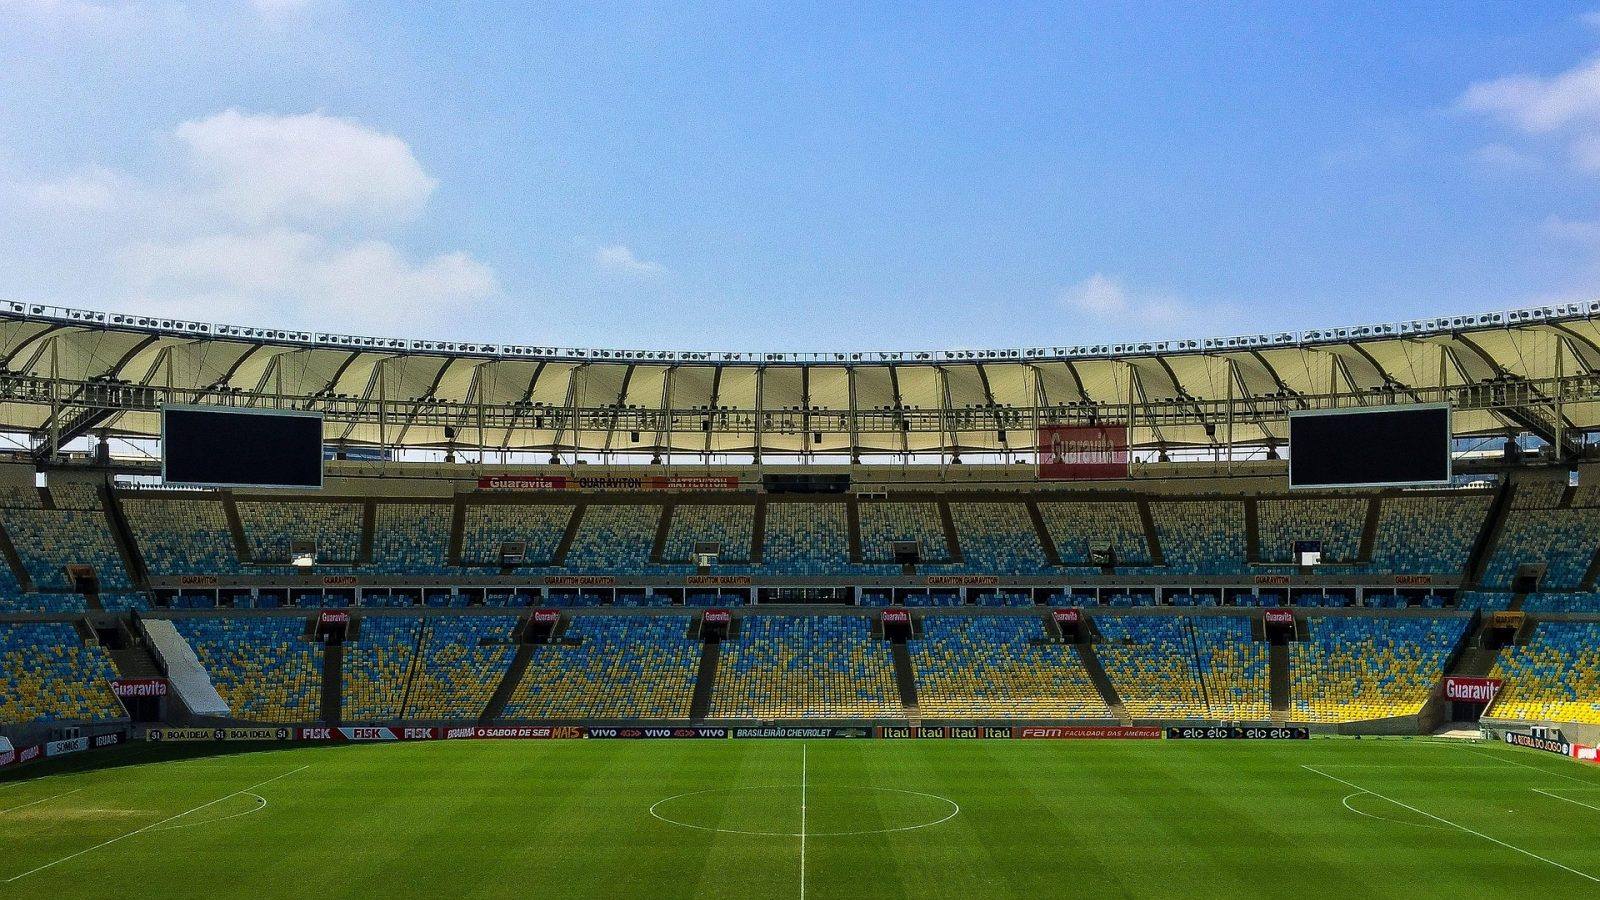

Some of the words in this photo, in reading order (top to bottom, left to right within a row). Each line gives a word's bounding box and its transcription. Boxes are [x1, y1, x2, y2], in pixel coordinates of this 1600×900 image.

[1052, 432, 1114, 464] Guaravita
[490, 478, 553, 488] Guaravita
[579, 477, 642, 488] GUARAVITON
[1266, 612, 1293, 622] Guaravita
[112, 680, 166, 696] Guaravita
[151, 730, 160, 740] 51
[215, 730, 224, 740] 51
[277, 728, 286, 738] 51
[302, 728, 331, 739] FISK
[354, 728, 381, 738] FISK
[404, 728, 432, 739] FISK
[448, 727, 475, 739] BRAHMA
[478, 728, 486, 736] O
[552, 726, 580, 739] MAIS
[736, 726, 786, 737] BRASILEIRÃO
[786, 728, 832, 737] CHEVROLET
[884, 728, 909, 738] Itaú
[918, 728, 943, 738] Itaú
[952, 728, 976, 738] Itaú
[985, 728, 1010, 738] Itaú
[1124, 729, 1160, 737] AMÉRICAS
[1183, 728, 1204, 738] elo
[1207, 728, 1228, 738] elo
[1246, 728, 1267, 738] elo
[1270, 728, 1291, 738] elo
[56, 740, 79, 752] SOMOS
[96, 734, 118, 747] IGUAIS
[1544, 740, 1562, 752] JOGO
